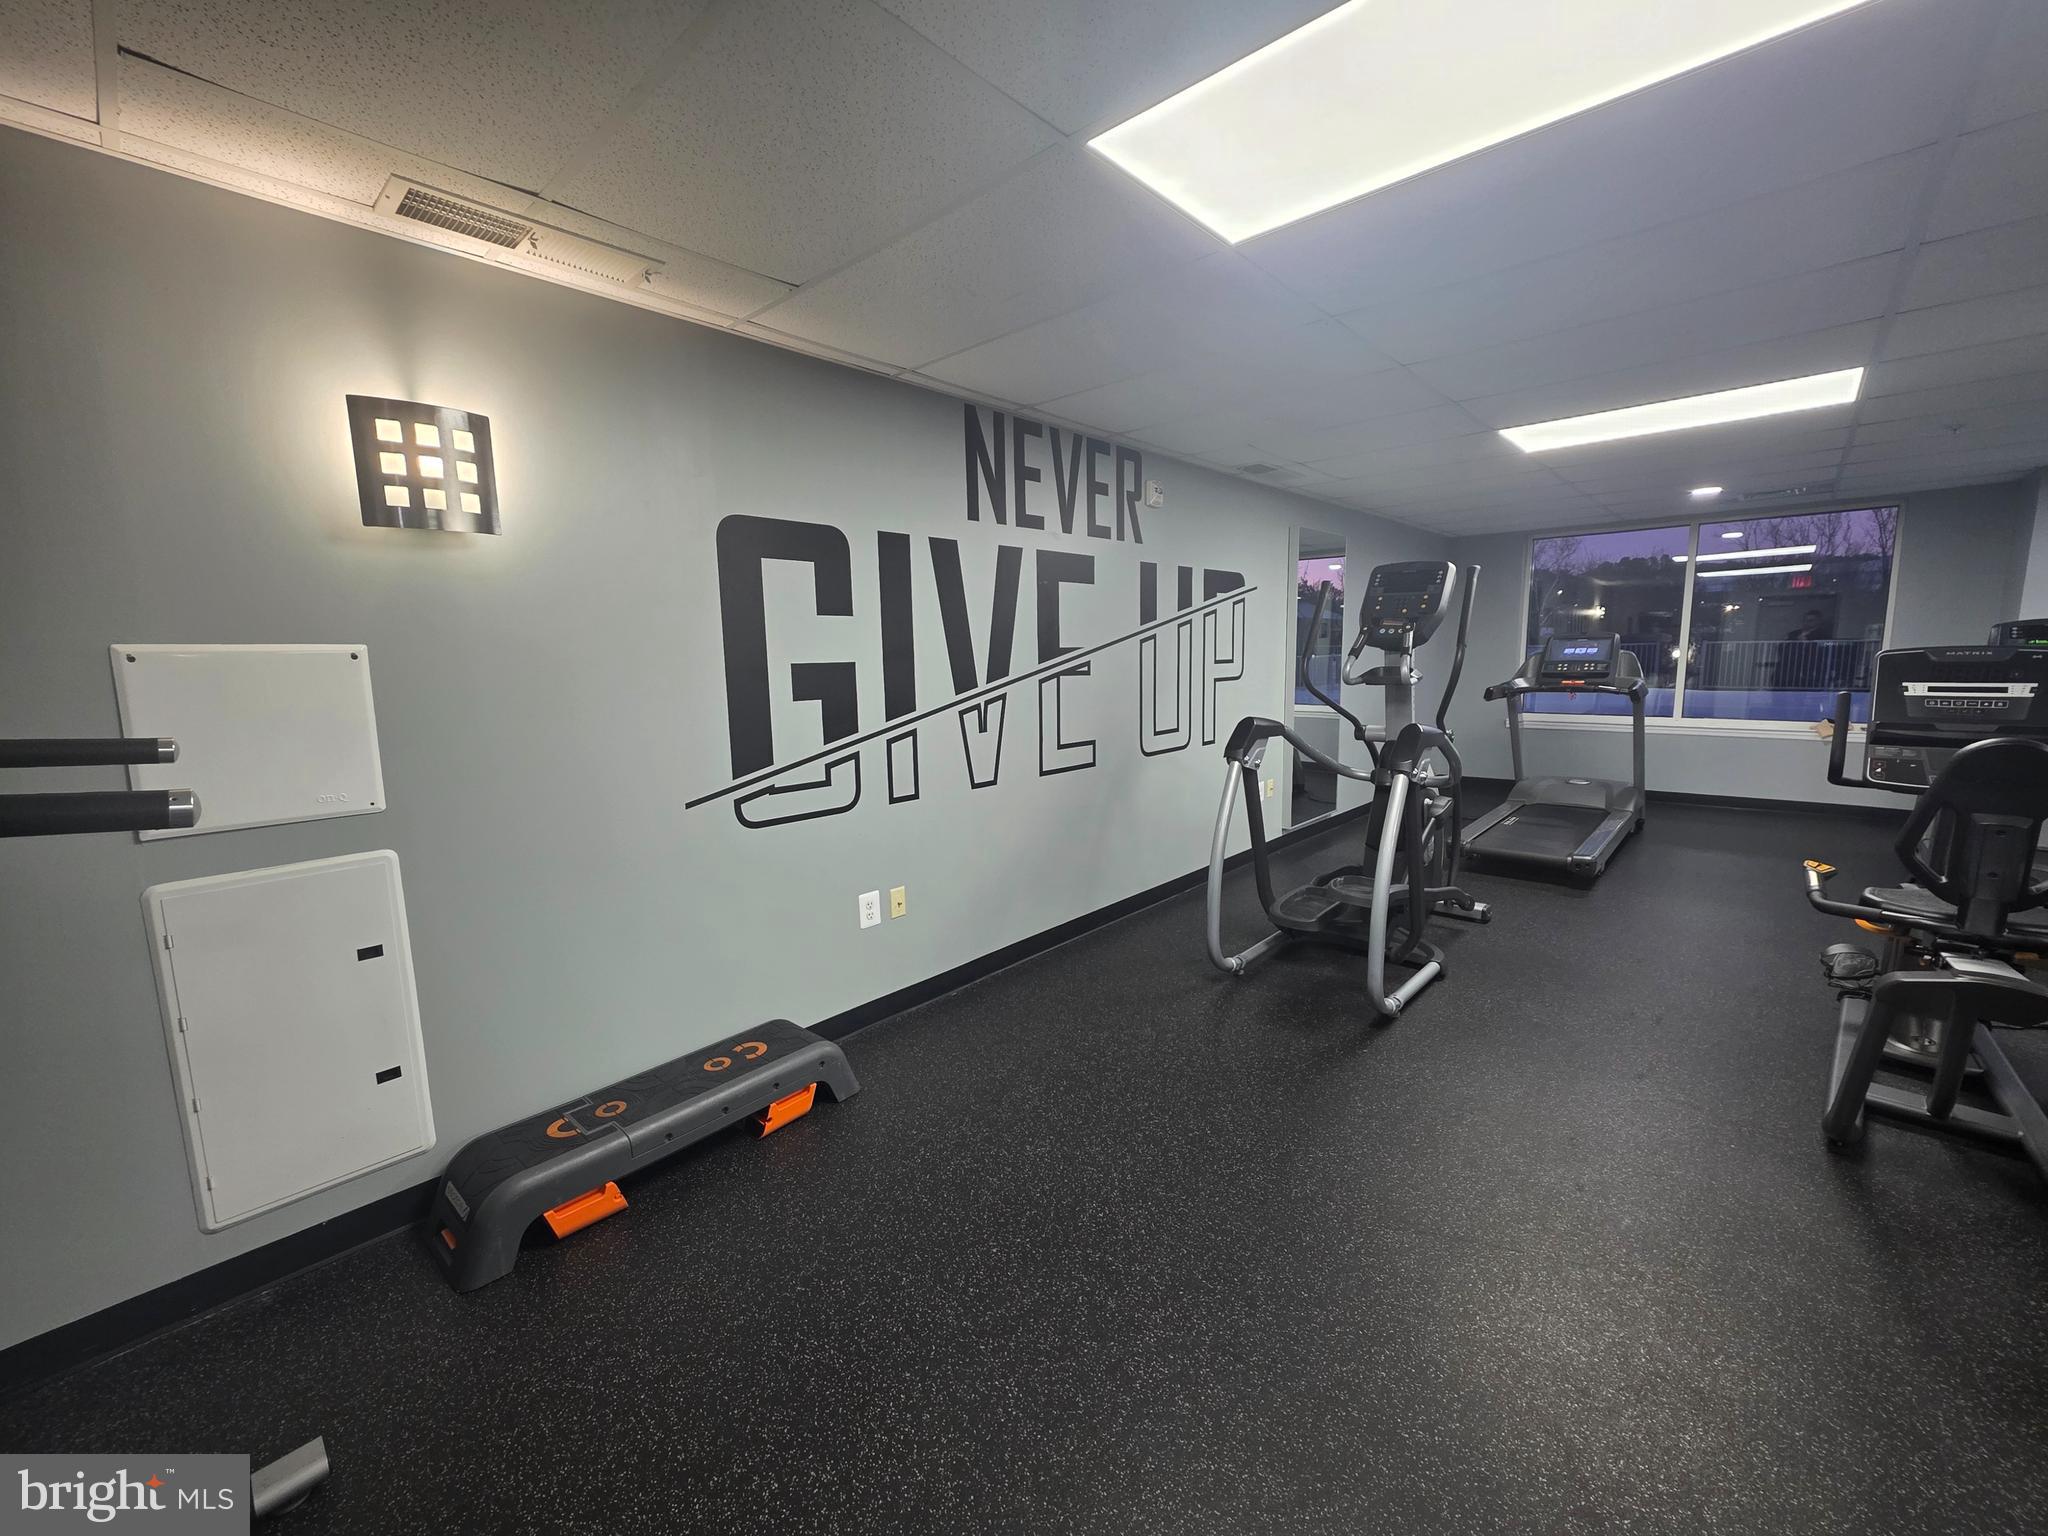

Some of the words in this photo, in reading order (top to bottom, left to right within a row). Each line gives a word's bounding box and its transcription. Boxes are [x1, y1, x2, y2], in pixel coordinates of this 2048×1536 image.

[963, 402, 1144, 544] NEVER
[715, 513, 1097, 829] GIVE
[1139, 560, 1246, 757] UP
